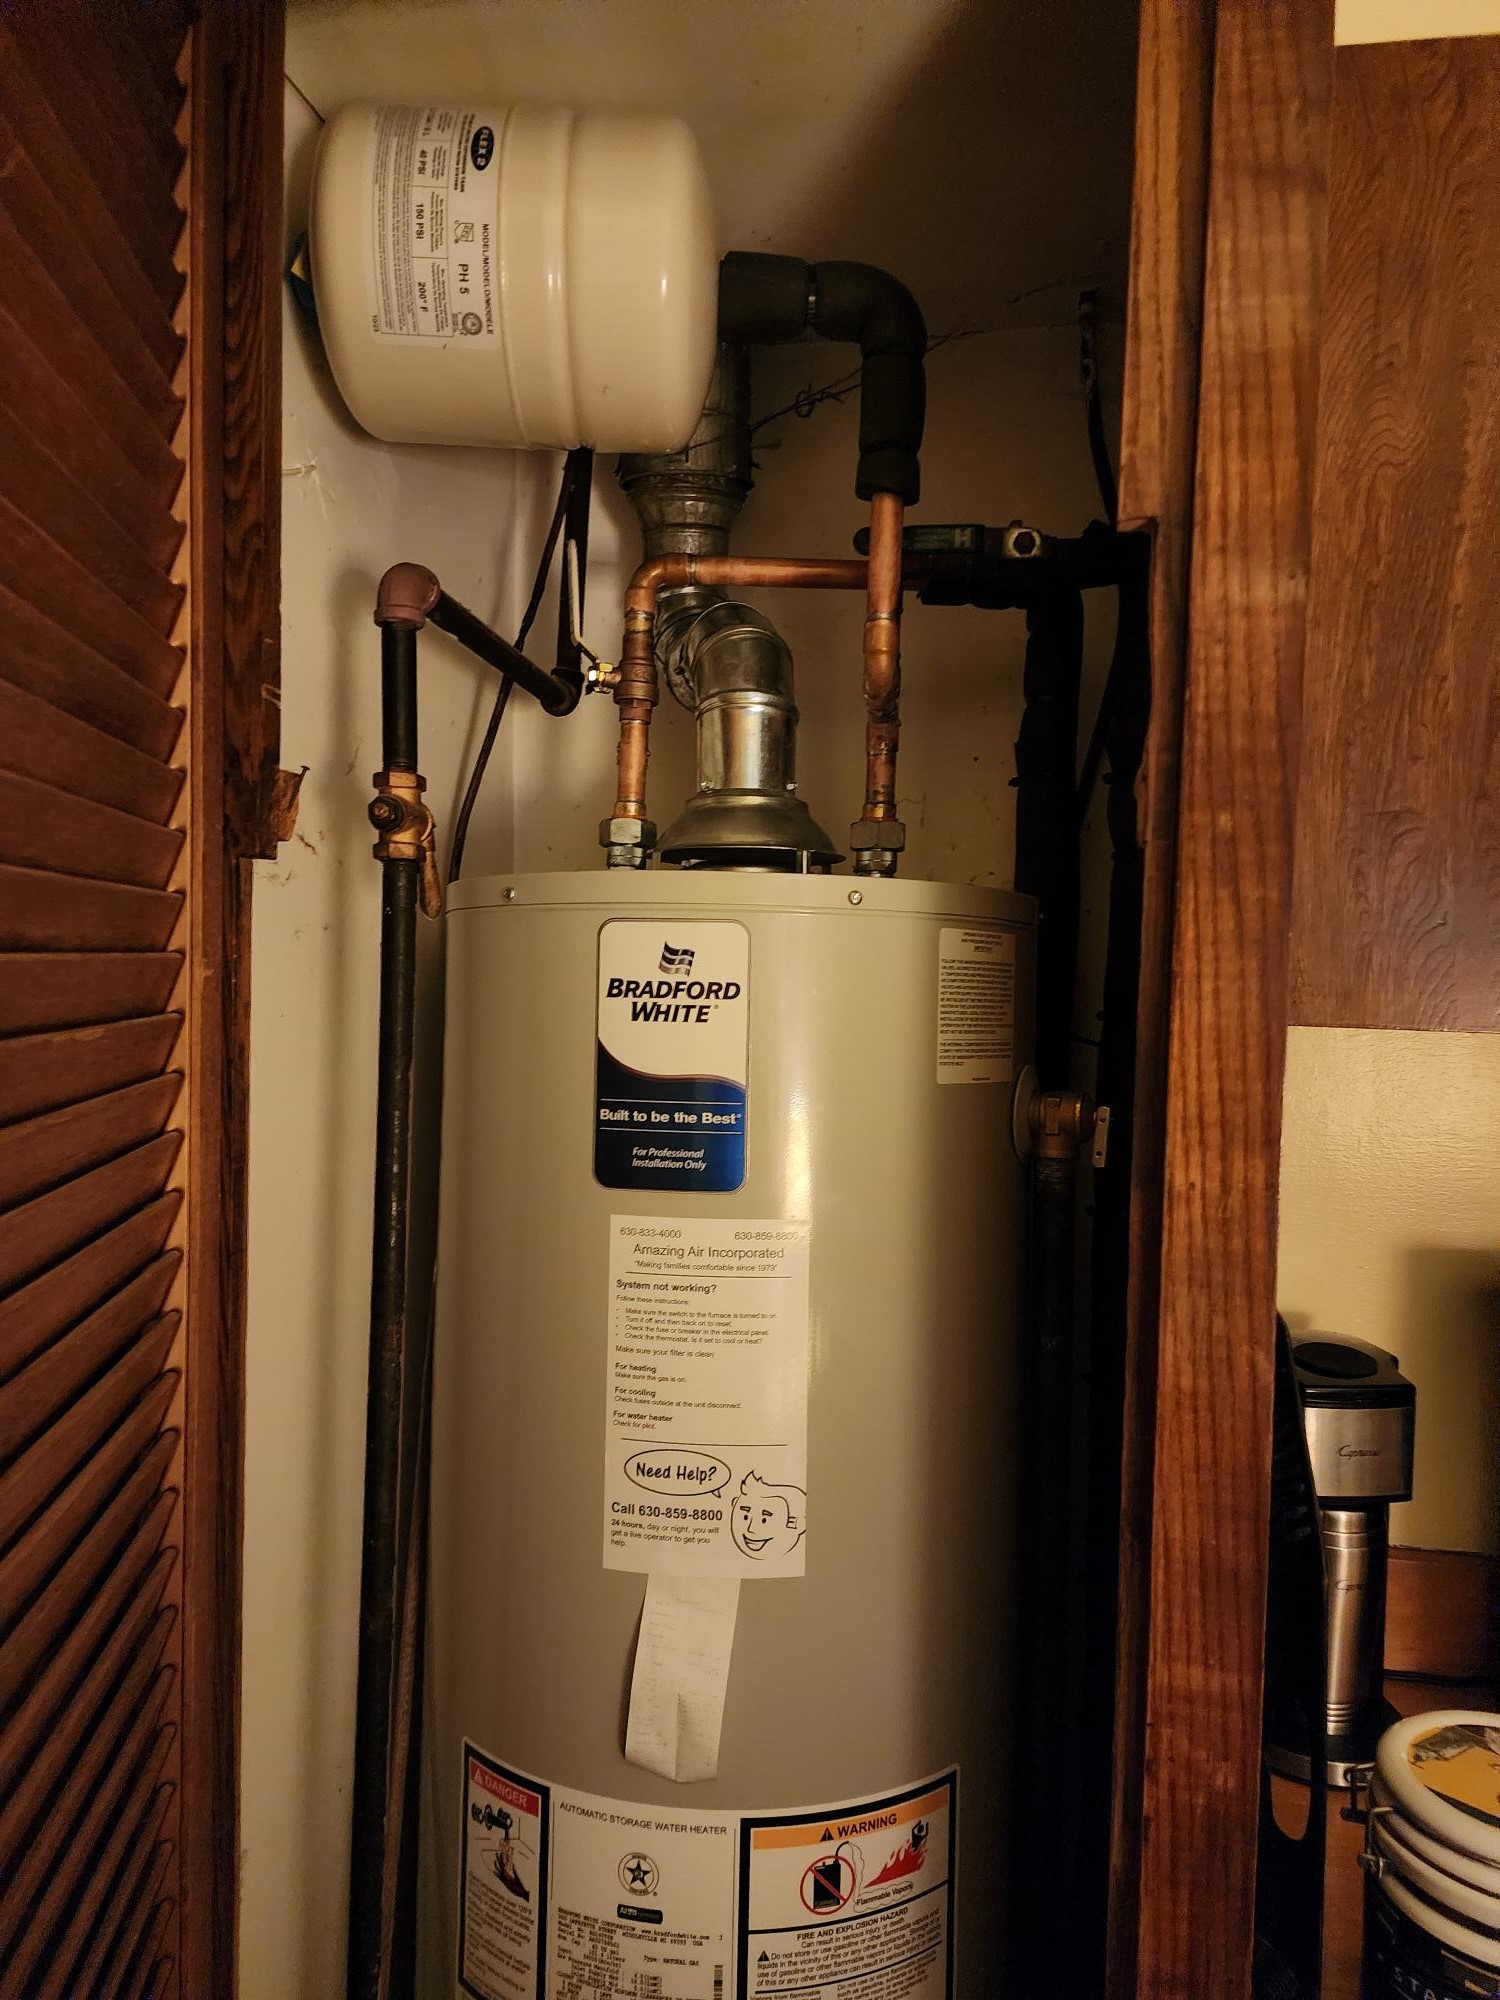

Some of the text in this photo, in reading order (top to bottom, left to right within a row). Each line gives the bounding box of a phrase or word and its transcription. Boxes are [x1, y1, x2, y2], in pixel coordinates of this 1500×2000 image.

[417, 160, 428, 175] PSI
[415, 203, 425, 240] 150 PSI
[458, 263, 470, 295] PH 5
[606, 978, 741, 1000] BRADFORD
[600, 1109, 630, 1121] Built
[632, 1111, 648, 1122] to
[650, 1111, 670, 1123] be
[673, 1112, 699, 1124] the
[632, 1147, 706, 1159] For Professional
[632, 1158, 708, 1171] Installation Only
[633, 1243, 786, 1261] Amazing Air Incorporated
[663, 1262, 691, 1271] families
[692, 1263, 735, 1272] comfortable
[616, 1279, 718, 1295] System not working?
[615, 1294, 635, 1303] Follow
[636, 1296, 653, 1304] these
[625, 1307, 642, 1315] Make
[657, 1309, 668, 1317] the
[669, 1310, 688, 1318] switch
[697, 1311, 707, 1319] the
[708, 1311, 732, 1319] furnace
[625, 1315, 639, 1323] Turn
[645, 1316, 655, 1324] off
[655, 1317, 666, 1325] and
[667, 1318, 681, 1326] then
[681, 1319, 697, 1327] back
[624, 1323, 643, 1332] Check
[645, 1325, 656, 1333] the
[656, 1326, 670, 1334] fuse
[678, 1327, 702, 1335] breaker
[624, 1332, 643, 1340] Check
[645, 1333, 655, 1341] the
[722, 1337, 736, 1345] cool
[615, 1345, 635, 1354] Make
[635, 1347, 652, 1355] sure
[652, 1349, 669, 1358] your
[669, 1348, 686, 1358] filter
[686, 1350, 694, 1358] is
[614, 1362, 658, 1375] For heating
[614, 1371, 631, 1379] Make
[632, 1373, 646, 1381] sure
[646, 1374, 657, 1382] the
[614, 1385, 657, 1399] For cooling
[614, 1395, 632, 1403] Check
[633, 1397, 651, 1405] fuses
[651, 1399, 674, 1407] outside
[693, 1401, 706, 1409] unit
[612, 1410, 674, 1422] For water heater
[612, 1419, 631, 1427] Check
[632, 1420, 641, 1428] for
[635, 1461, 718, 1486] Need Help?
[611, 1501, 723, 1522] Call 630-859-8800
[611, 1518, 621, 1527] 24
[621, 1520, 646, 1531] hours,
[646, 1523, 660, 1533] day
[660, 1525, 670, 1533] or
[692, 1527, 707, 1536] you
[707, 1526, 721, 1535] will
[611, 1529, 623, 1538] get
[629, 1530, 643, 1539] live
[643, 1533, 674, 1543] operator
[674, 1534, 683, 1543] to
[683, 1536, 696, 1545] get
[697, 1537, 712, 1546] you
[482, 1773, 528, 1809] DANGER
[559, 1801, 728, 1836] AUTOMATIC STORAGE WATER HEATER
[837, 1812, 899, 1838] WARNING
[855, 1882, 914, 1907] Flammable Vapors
[796, 1905, 909, 1941] FIRE AND EXPLOSION HAZARD
[801, 1940, 815, 1949] Can
[816, 1937, 834, 1947] result
[842, 1931, 864, 1942] serious
[865, 1926, 881, 1937] injury
